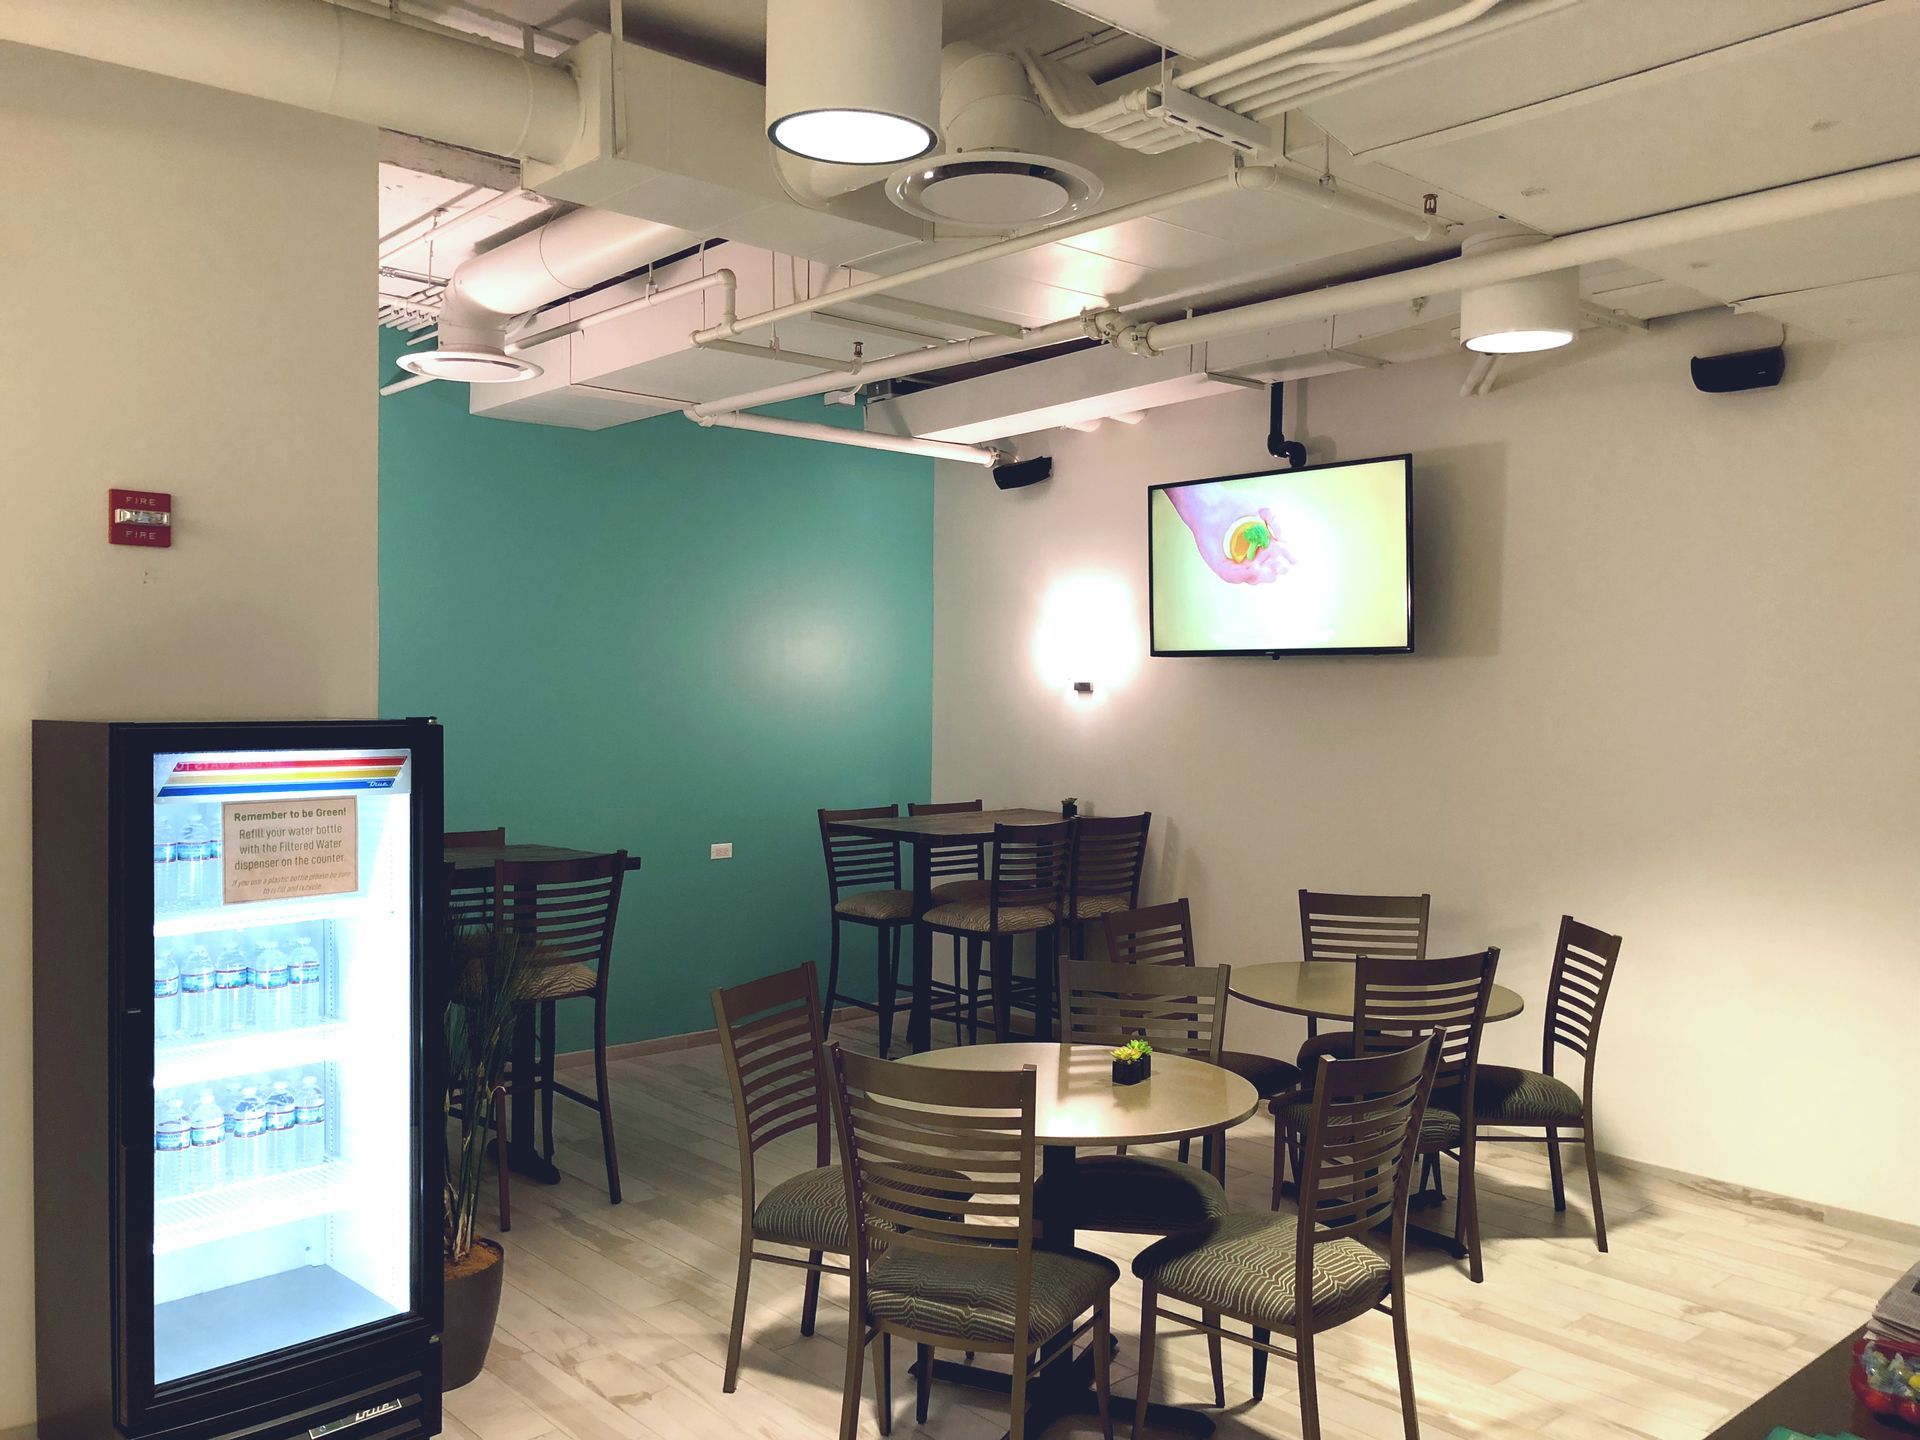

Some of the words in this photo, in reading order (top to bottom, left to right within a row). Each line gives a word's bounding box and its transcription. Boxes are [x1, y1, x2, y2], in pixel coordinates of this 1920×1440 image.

[125, 496, 157, 506] FIRE
[125, 531, 157, 540] FIRE
[234, 811, 287, 822] Remember
[290, 810, 300, 819] to
[302, 809, 314, 818] be
[316, 807, 347, 817] Green!
[239, 828, 264, 839] Refill
[266, 829, 285, 840] your
[288, 826, 314, 836] water
[316, 824, 342, 835] bottle
[239, 845, 260, 855] with
[262, 844, 277, 854] the
[279, 841, 314, 852] Filtered
[316, 839, 342, 849] Water
[234, 858, 278, 871] dispenser
[281, 858, 292, 867] on
[295, 856, 309, 866] the
[355, 1402, 394, 1421] true
